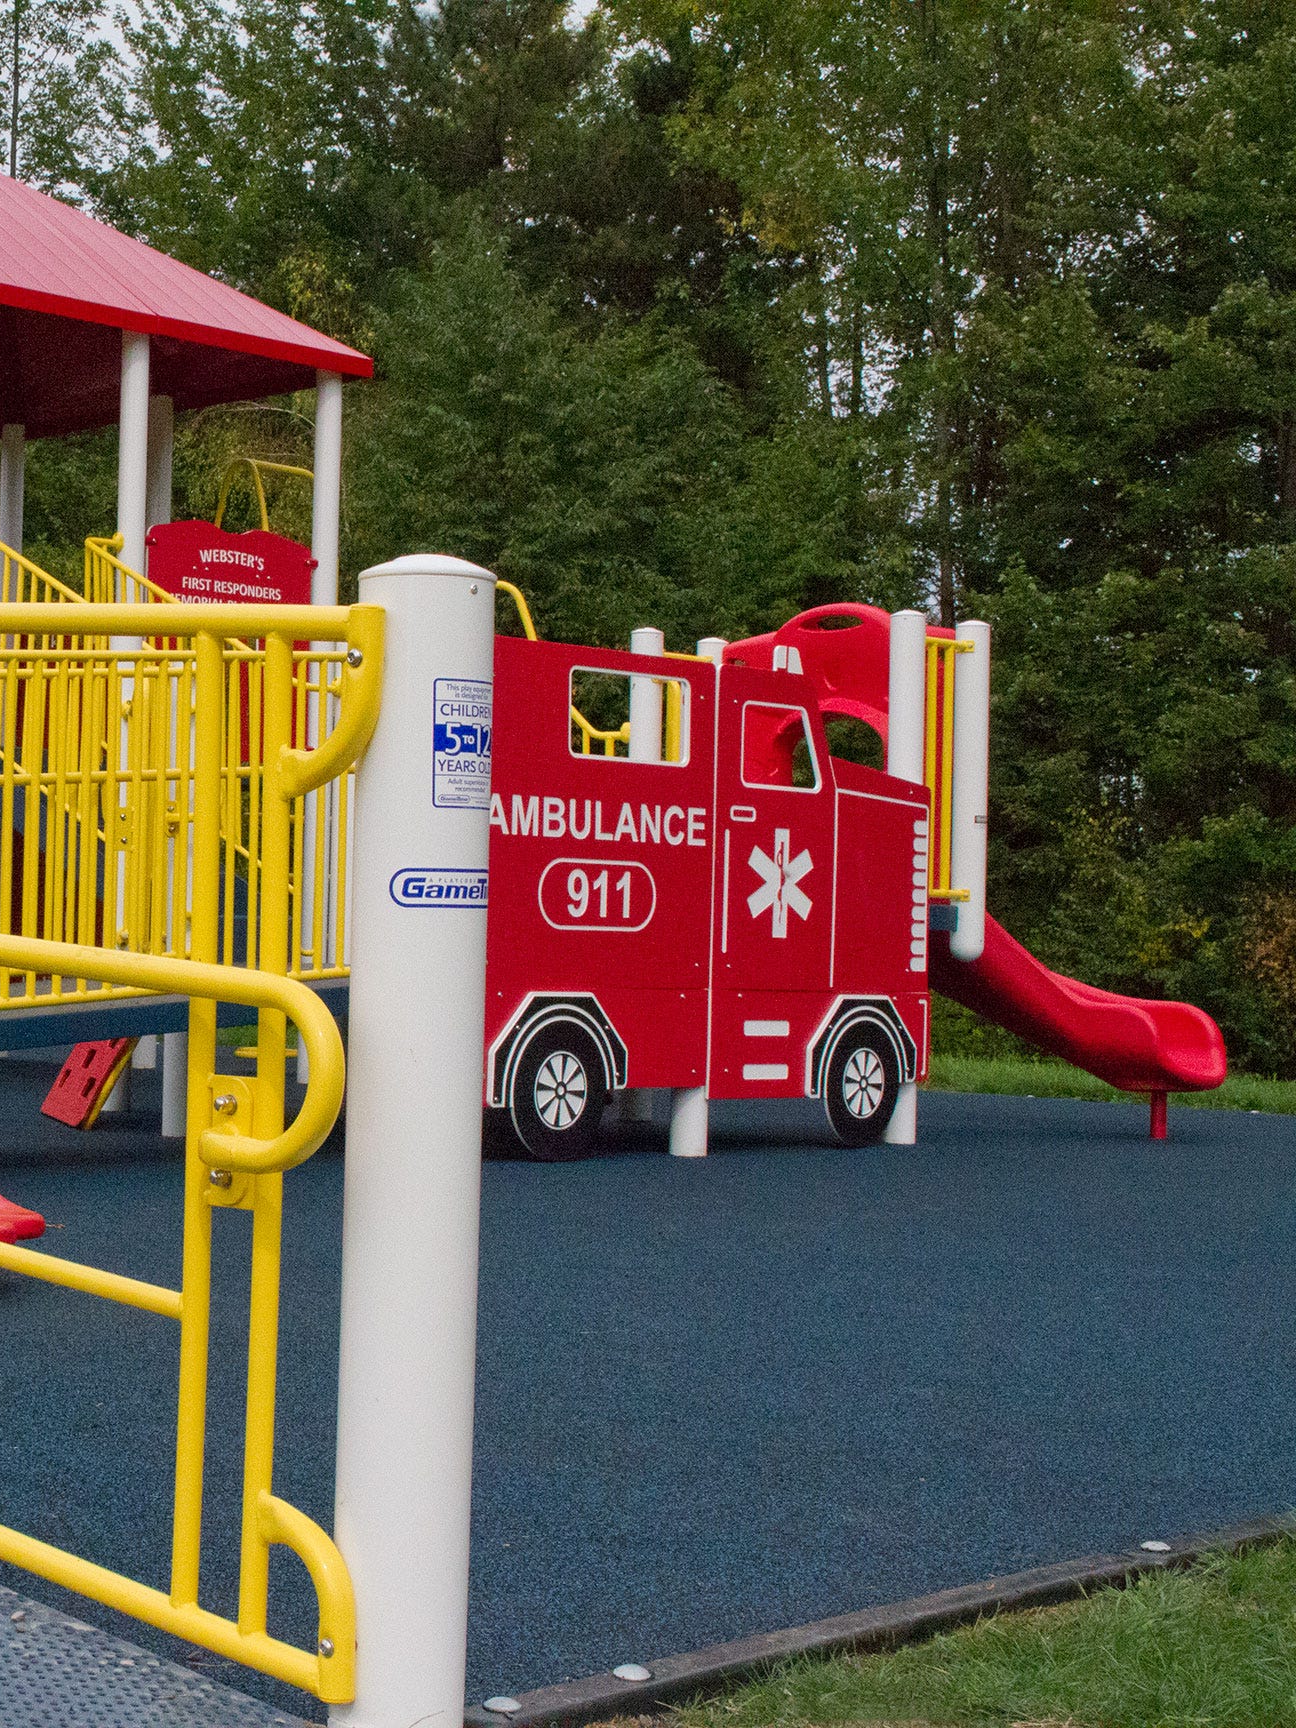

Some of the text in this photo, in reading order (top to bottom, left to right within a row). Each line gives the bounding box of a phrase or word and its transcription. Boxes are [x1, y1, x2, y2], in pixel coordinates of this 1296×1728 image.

[199, 549, 265, 571] WEBSTER'S
[181, 576, 281, 601] FIRST RESPONDERS
[445, 721, 491, 758] 5 TO 12
[437, 759, 476, 773] YEARS
[489, 792, 707, 847] AMBULANCE
[567, 868, 631, 919] 911
